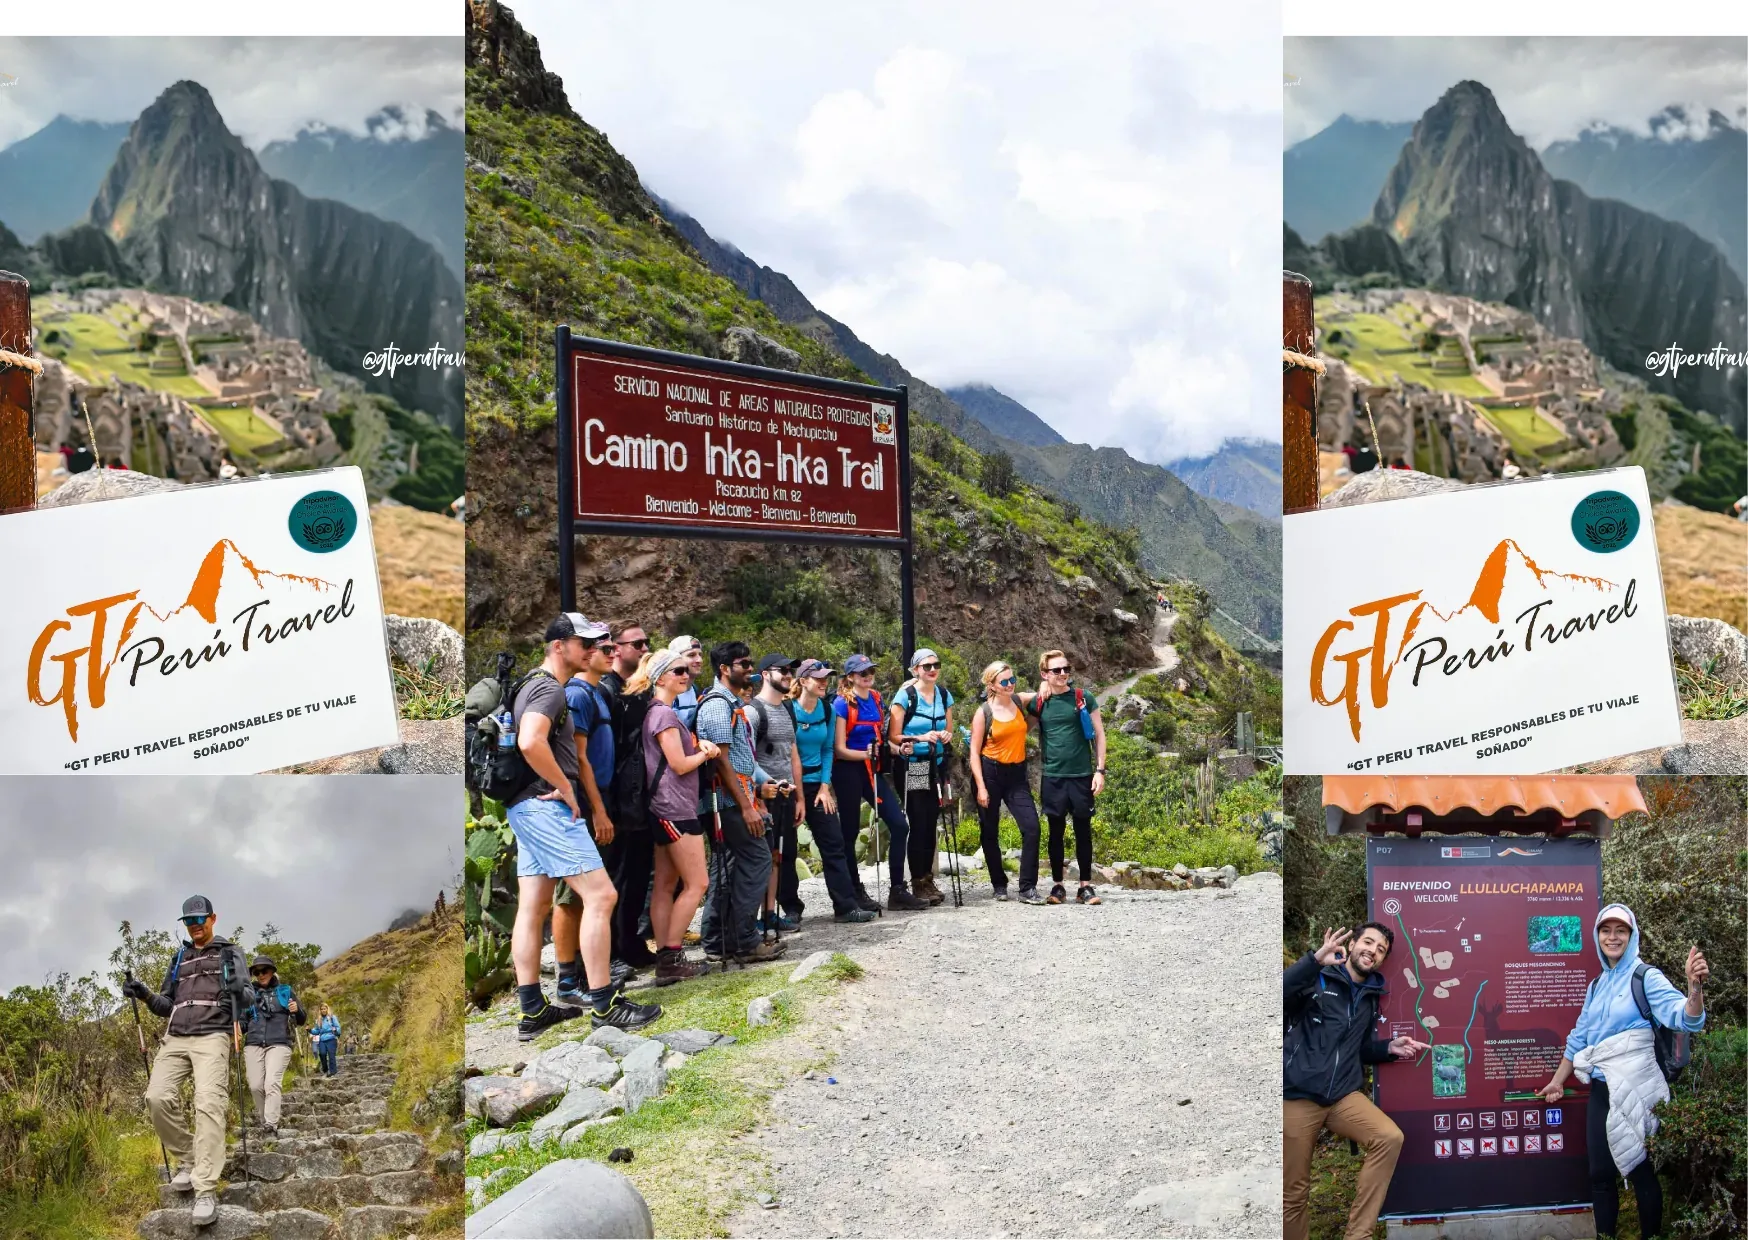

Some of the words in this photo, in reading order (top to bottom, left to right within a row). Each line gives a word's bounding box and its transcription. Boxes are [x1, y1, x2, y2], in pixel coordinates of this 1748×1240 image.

[665, 405, 713, 426] Santuario
[719, 412, 761, 432] Histórico
[767, 419, 778, 434] de
[783, 420, 837, 442] Machupicchu
[666, 383, 713, 405] NACIONAL
[720, 390, 732, 408] DE
[739, 394, 768, 412] AREAS
[774, 399, 823, 420] NATURALES
[827, 406, 871, 426] PROTEGIDAS
[584, 418, 688, 472] Camino
[704, 432, 828, 486] Inka-Inka
[837, 446, 884, 491] Trail
[646, 495, 698, 514] Bienvenido
[709, 500, 752, 518] Welcome
[762, 504, 800, 520] Bienvenu
[810, 507, 856, 525] Benvenuto
[716, 479, 768, 500] Piscacucho
[791, 490, 802, 502] 82
[28, 590, 140, 743] GT
[120, 629, 232, 686] Perú
[232, 578, 354, 652] Travel
[1310, 589, 1423, 743] GT
[1403, 629, 1514, 686] Perú
[1516, 578, 1637, 652] Travel
[94, 749, 130, 766] PERU
[134, 736, 185, 756] TRAVEL
[189, 711, 283, 742] RESPONSABLES
[286, 707, 302, 718] DE
[305, 703, 320, 714] TU
[323, 695, 357, 709] VIAJE
[1377, 749, 1413, 766] PERU
[1417, 736, 1468, 756] TRAVEL
[1471, 711, 1566, 742] RESPONSABLES
[1569, 707, 1585, 718] DE
[1588, 703, 1603, 714] TU
[1606, 695, 1640, 709] VIAJE
[1382, 881, 1451, 891] BIENVENIDO
[1414, 894, 1458, 903] WELCOME
[1460, 883, 1584, 894] LLULLUCHAPAMPA
